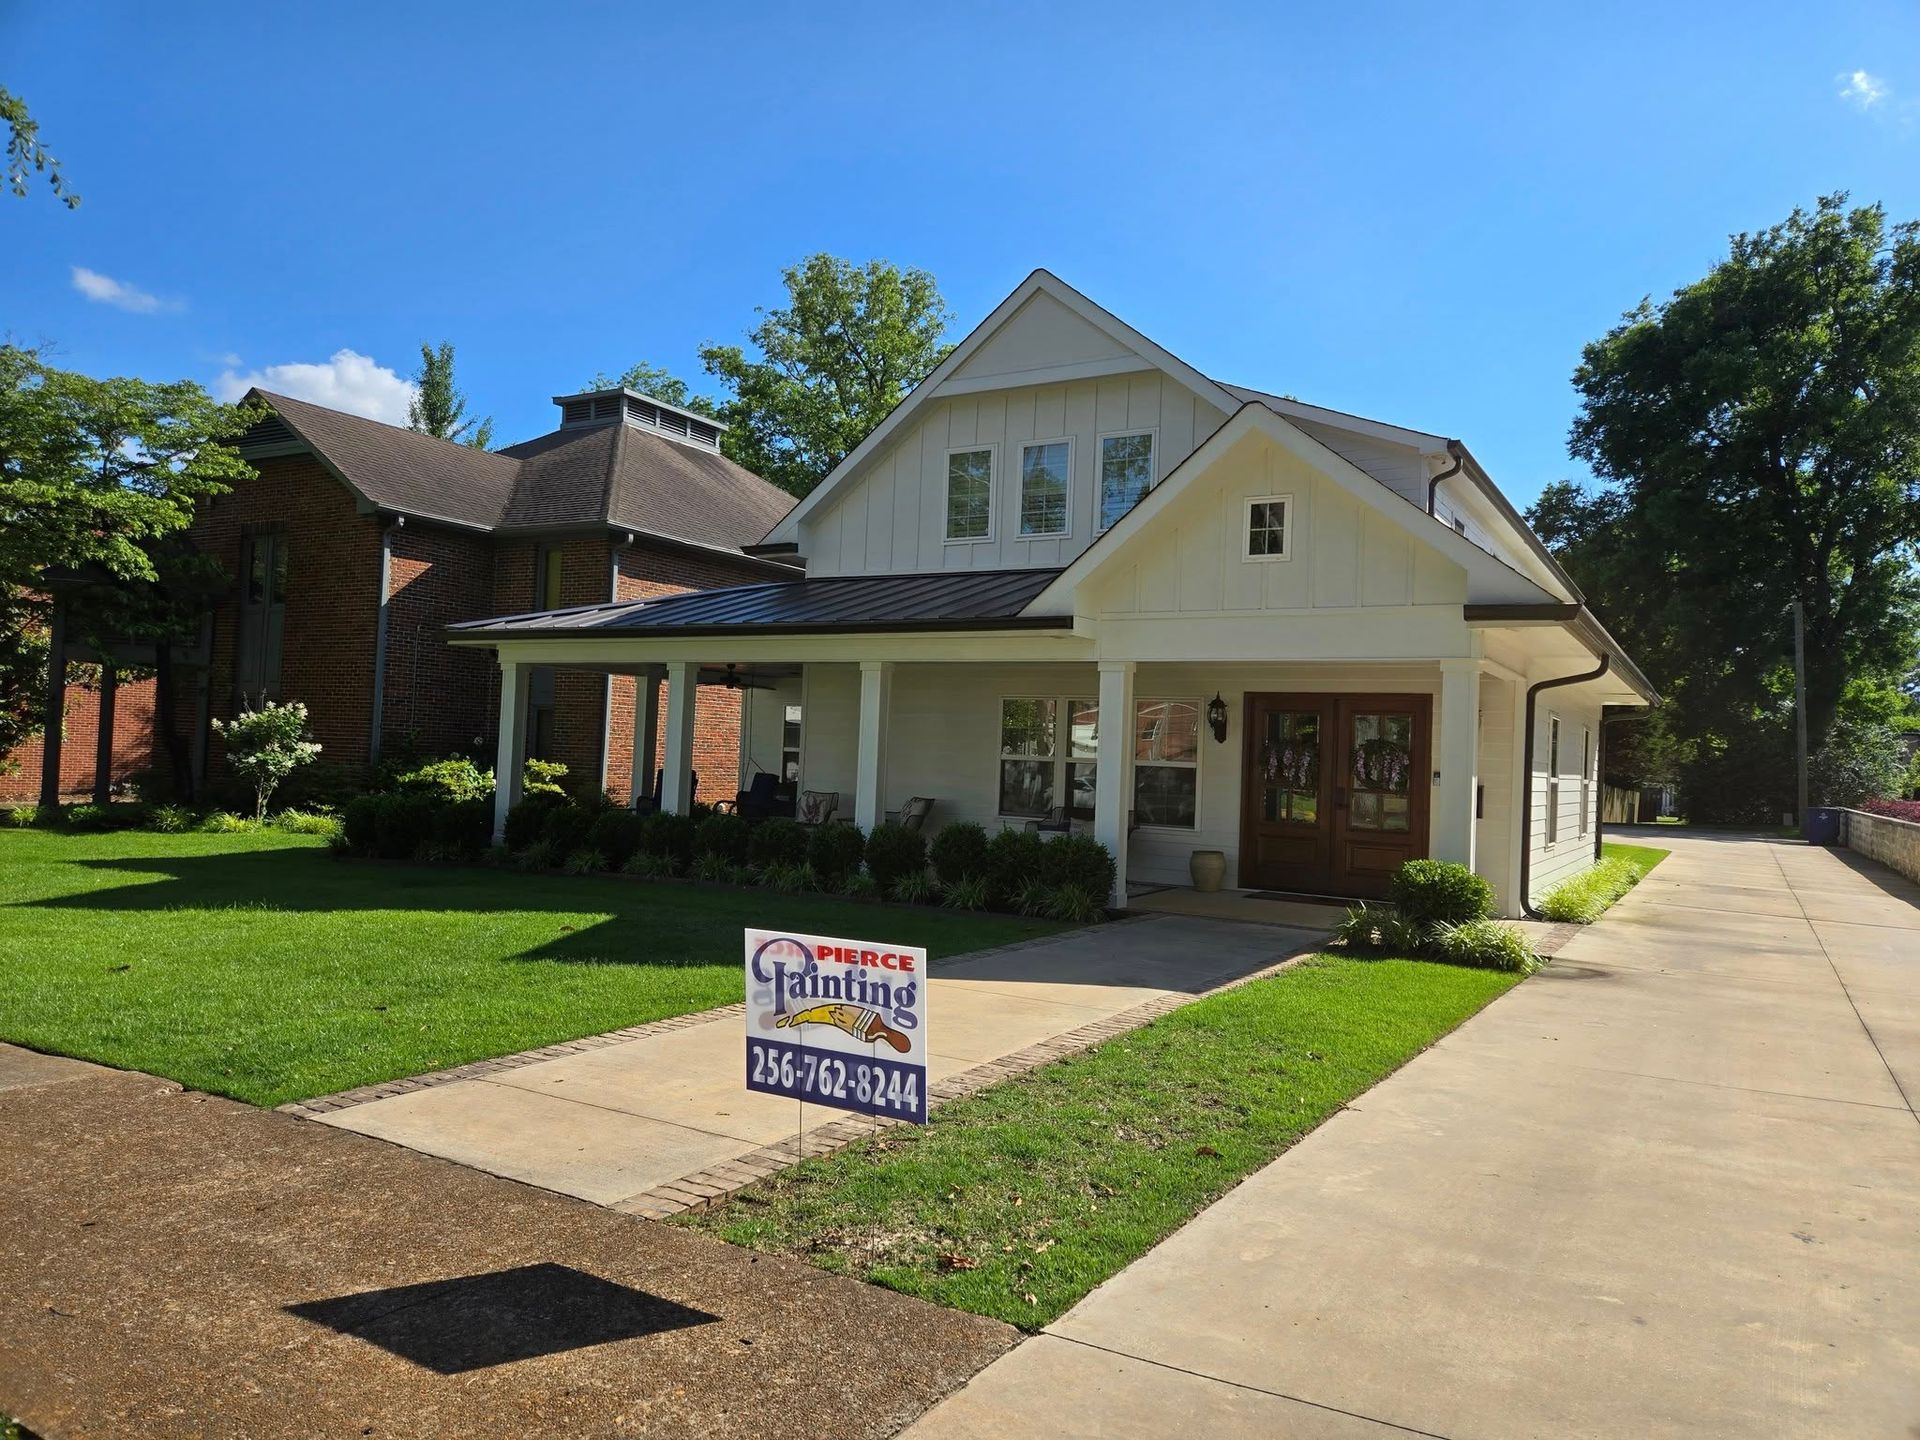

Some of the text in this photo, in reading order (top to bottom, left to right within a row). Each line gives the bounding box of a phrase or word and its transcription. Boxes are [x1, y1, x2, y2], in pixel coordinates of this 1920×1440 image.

[752, 938, 918, 1030] Painting
[817, 945, 915, 972] PIERCE
[752, 1045, 919, 1112] 256-762-8244
